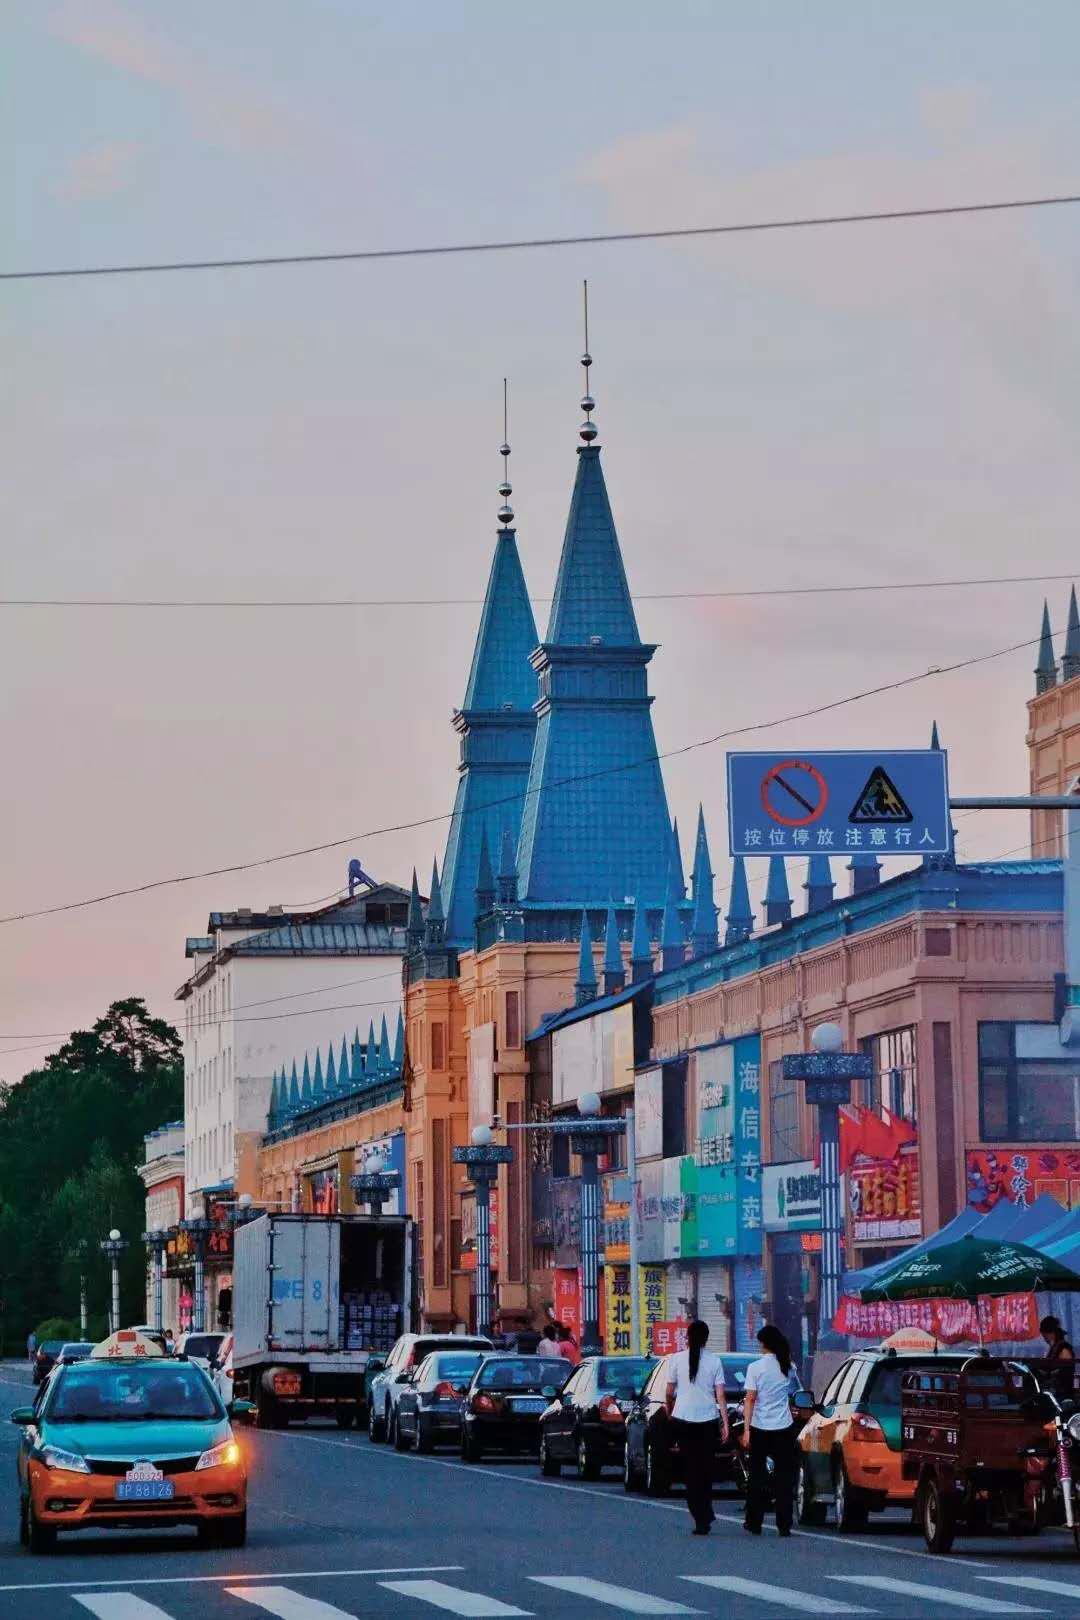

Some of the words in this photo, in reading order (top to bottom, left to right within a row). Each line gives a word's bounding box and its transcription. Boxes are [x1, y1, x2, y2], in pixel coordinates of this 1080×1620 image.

[744, 829, 834, 847] 按位停放
[845, 828, 936, 846] 注意行人
[909, 1263, 942, 1272] BEER
